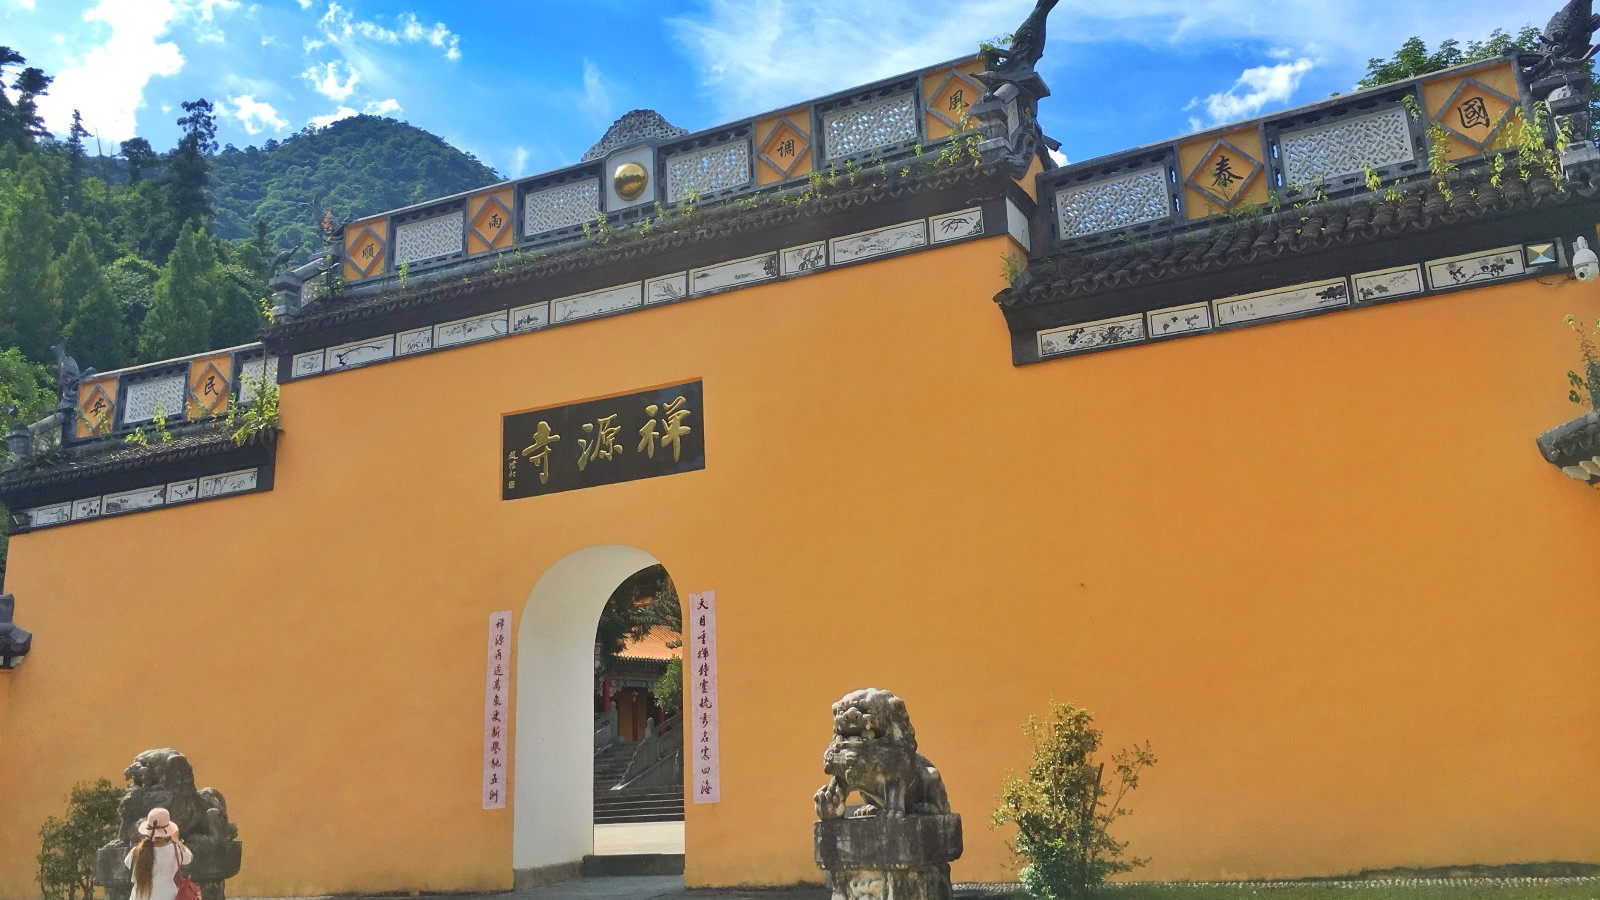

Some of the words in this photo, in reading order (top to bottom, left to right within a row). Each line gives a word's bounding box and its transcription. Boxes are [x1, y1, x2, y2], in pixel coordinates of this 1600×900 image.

[1457, 96, 1490, 129] 國
[1211, 155, 1244, 187] 泰
[488, 213, 502, 229] 雨
[204, 375, 219, 396] 民
[90, 397, 107, 417] 安
